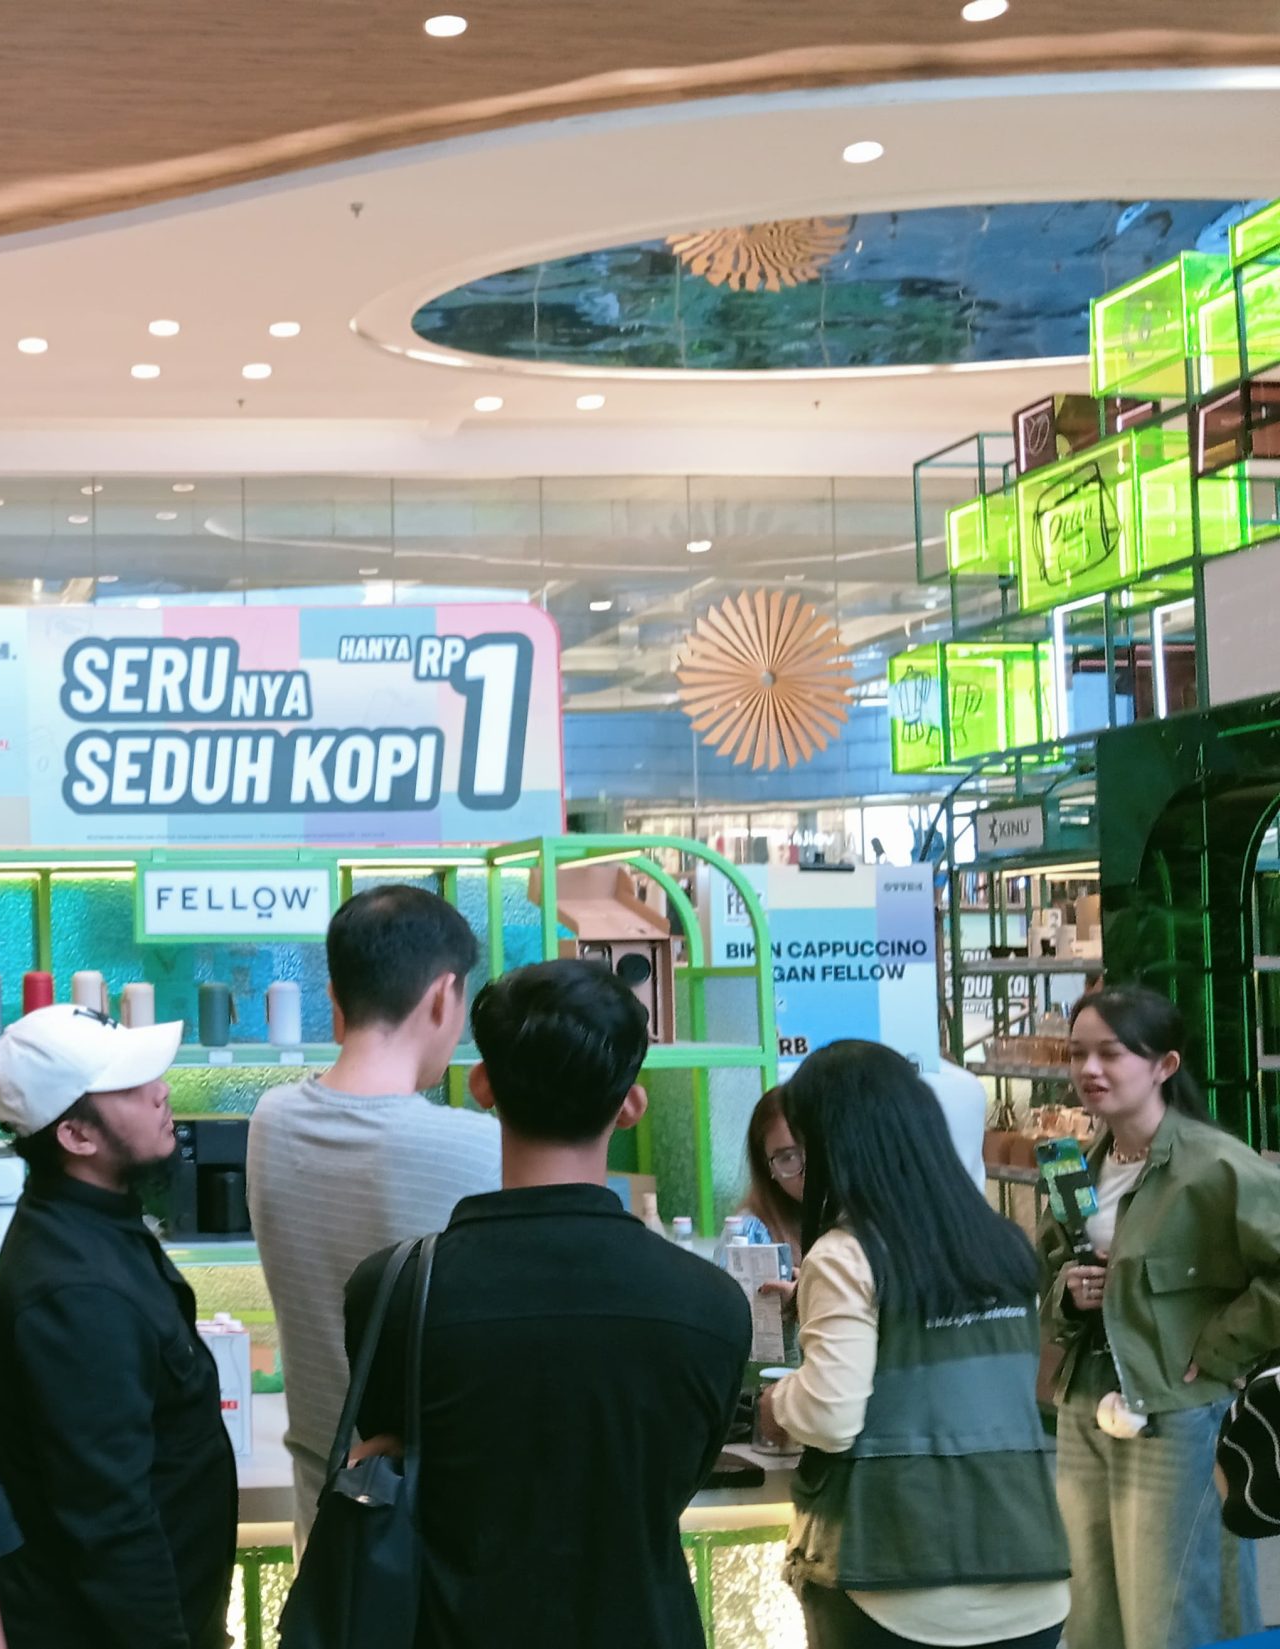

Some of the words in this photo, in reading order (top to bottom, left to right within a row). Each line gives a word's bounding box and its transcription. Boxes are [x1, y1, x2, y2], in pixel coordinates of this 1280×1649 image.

[339, 637, 411, 661] HANYA
[71, 736, 275, 806] SEDUH
[290, 734, 437, 804] KOPI
[157, 886, 311, 912] FELLOW
[726, 942, 782, 959] BIKN
[787, 939, 927, 959] CAPPUCCINO
[821, 964, 906, 982] FELLOW
